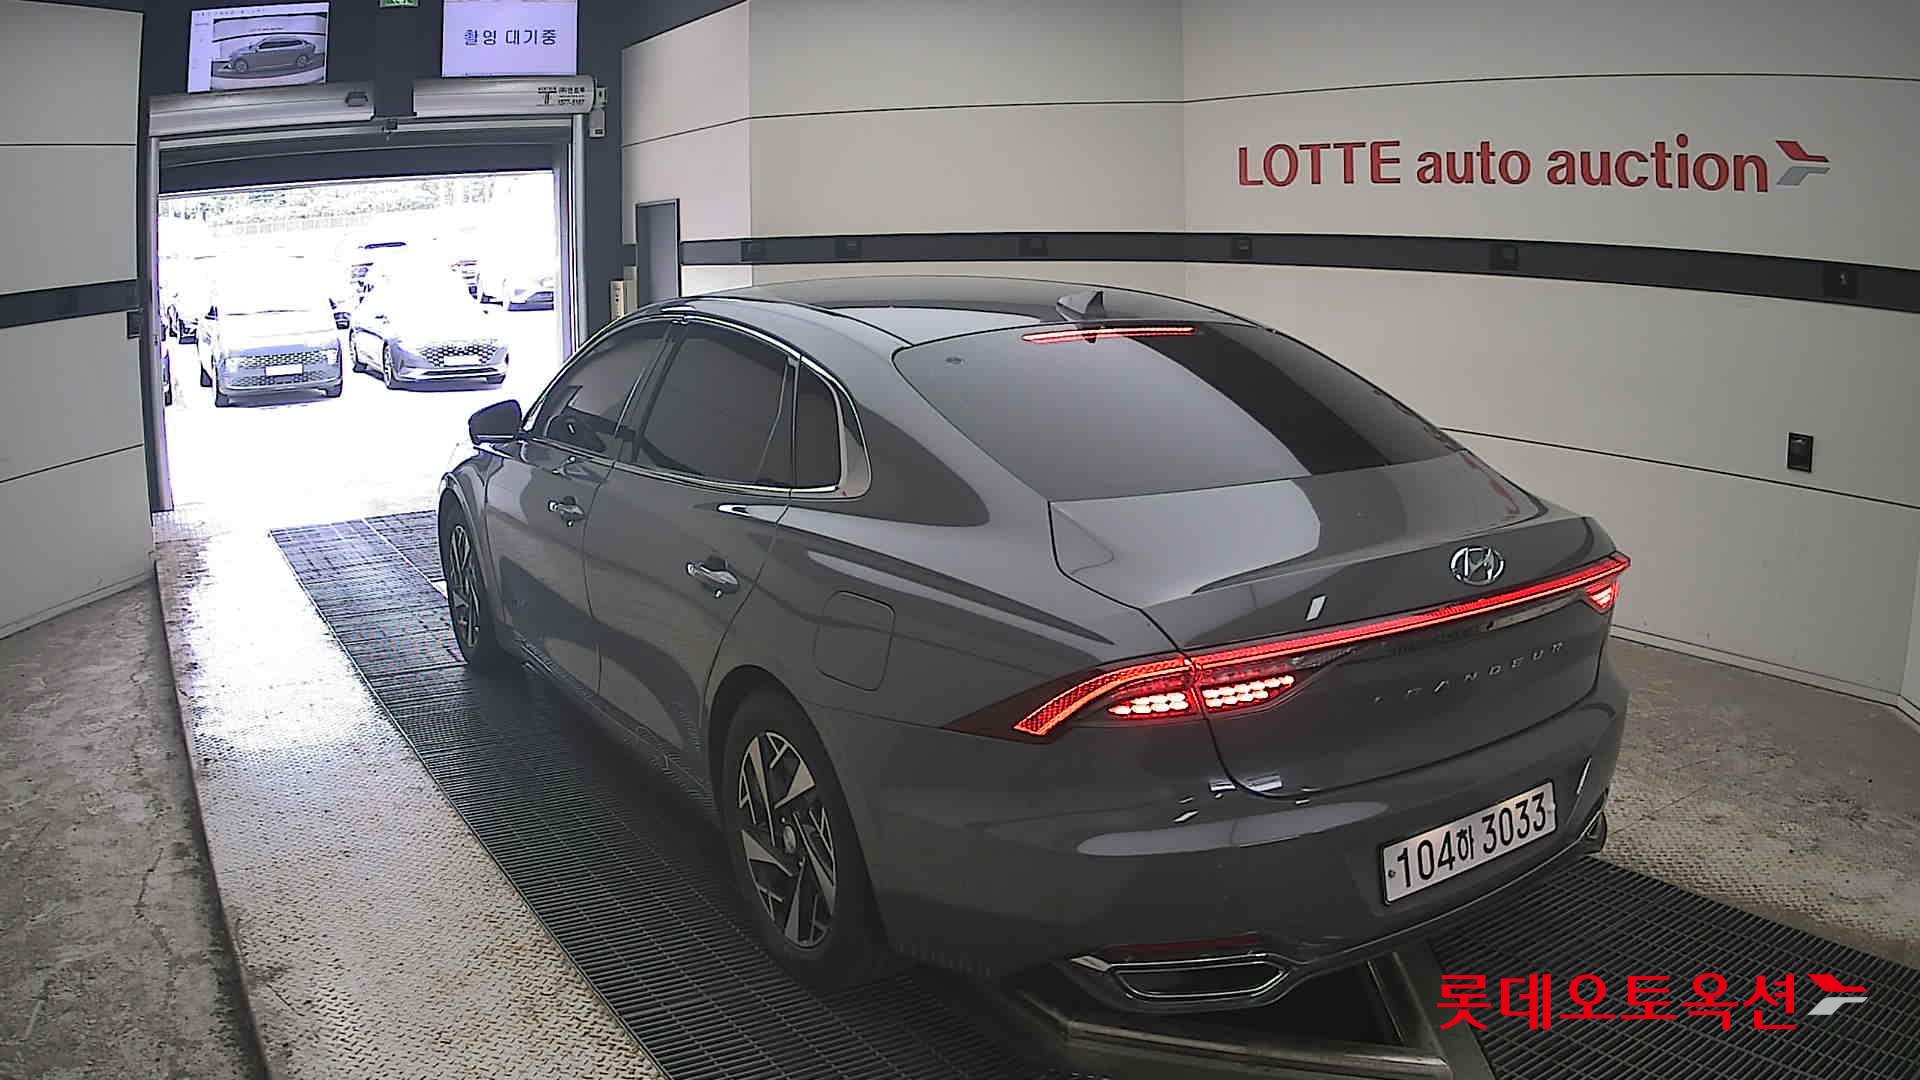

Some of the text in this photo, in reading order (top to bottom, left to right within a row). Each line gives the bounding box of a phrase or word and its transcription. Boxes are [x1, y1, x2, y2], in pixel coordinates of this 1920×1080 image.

[504, 28, 557, 46] 대기중
[1238, 133, 1769, 192] LOTTE auto auction
[1397, 792, 1547, 888] 104하 3033
